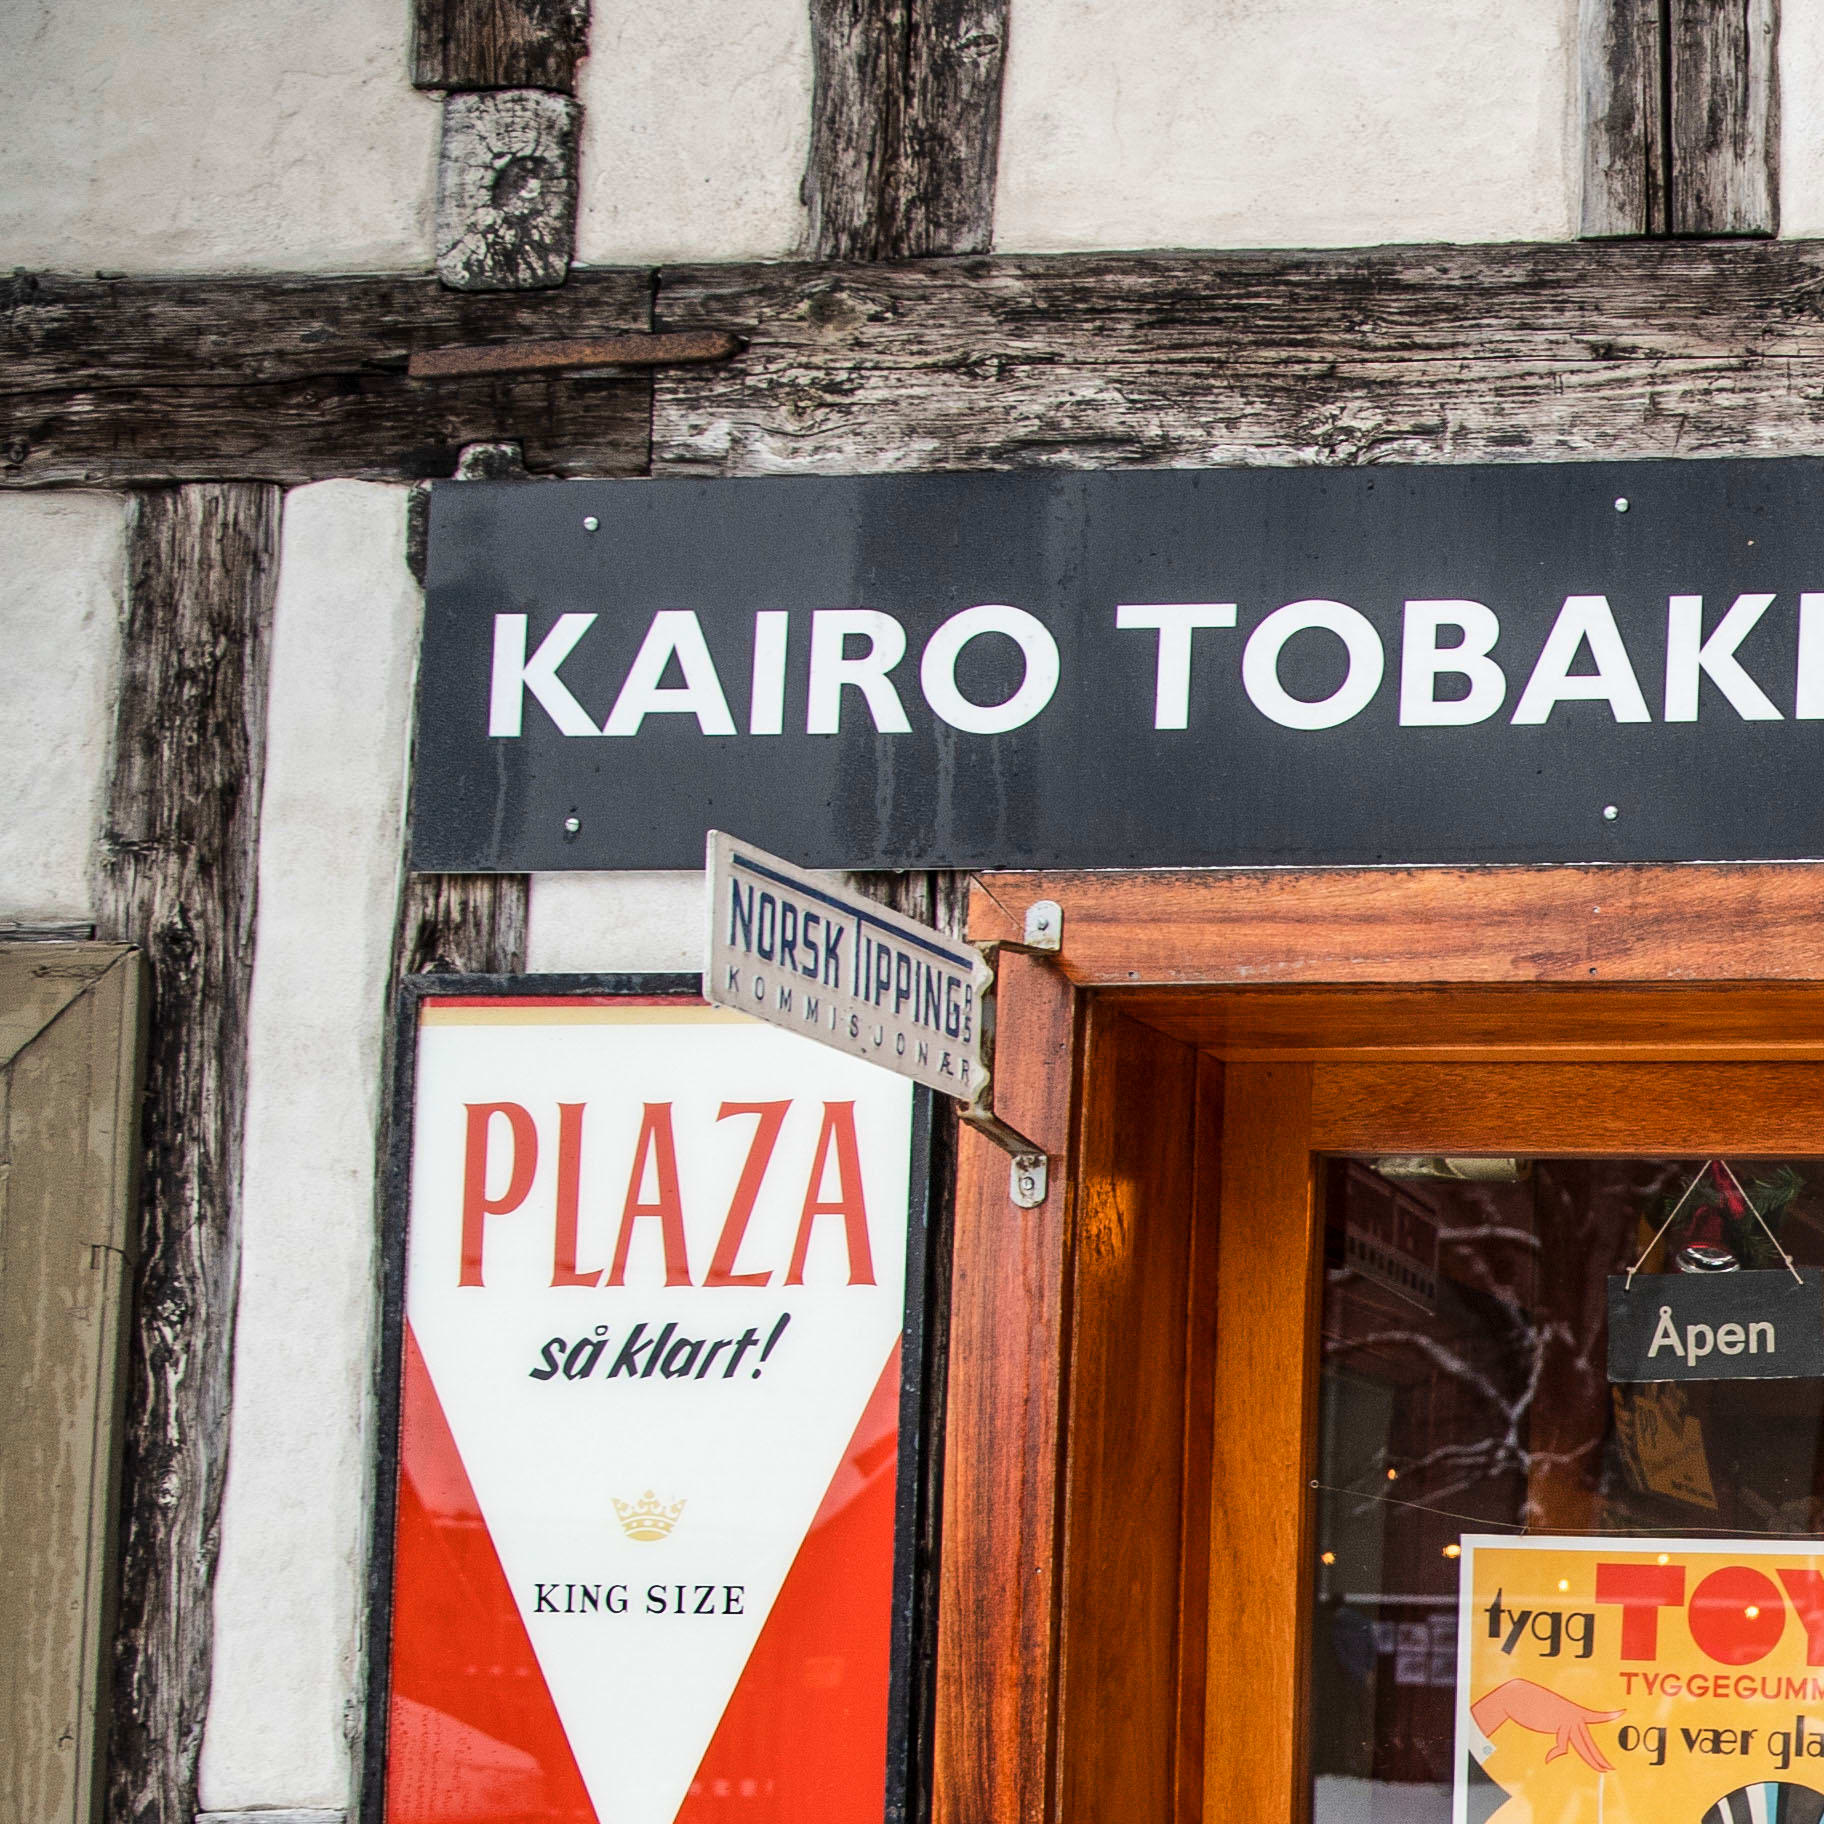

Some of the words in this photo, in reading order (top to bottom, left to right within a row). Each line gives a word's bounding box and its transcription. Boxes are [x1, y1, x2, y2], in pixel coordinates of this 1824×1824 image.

[488, 604, 1060, 737] KAIRO
[729, 878, 844, 989] NORSK
[853, 916, 962, 1039] TIPPING
[728, 965, 970, 1087] KOMMISJONÆR
[457, 1099, 877, 1288] PLAZA
[530, 1324, 607, 1380] så
[607, 1312, 791, 1380] klart!
[1648, 1305, 1776, 1367] Åpen
[534, 1583, 629, 1614] KING
[646, 1584, 746, 1616] SIZE
[1484, 1588, 1596, 1659] tygg
[1617, 1724, 1667, 1766] og
[1680, 1727, 1758, 1757] vær
